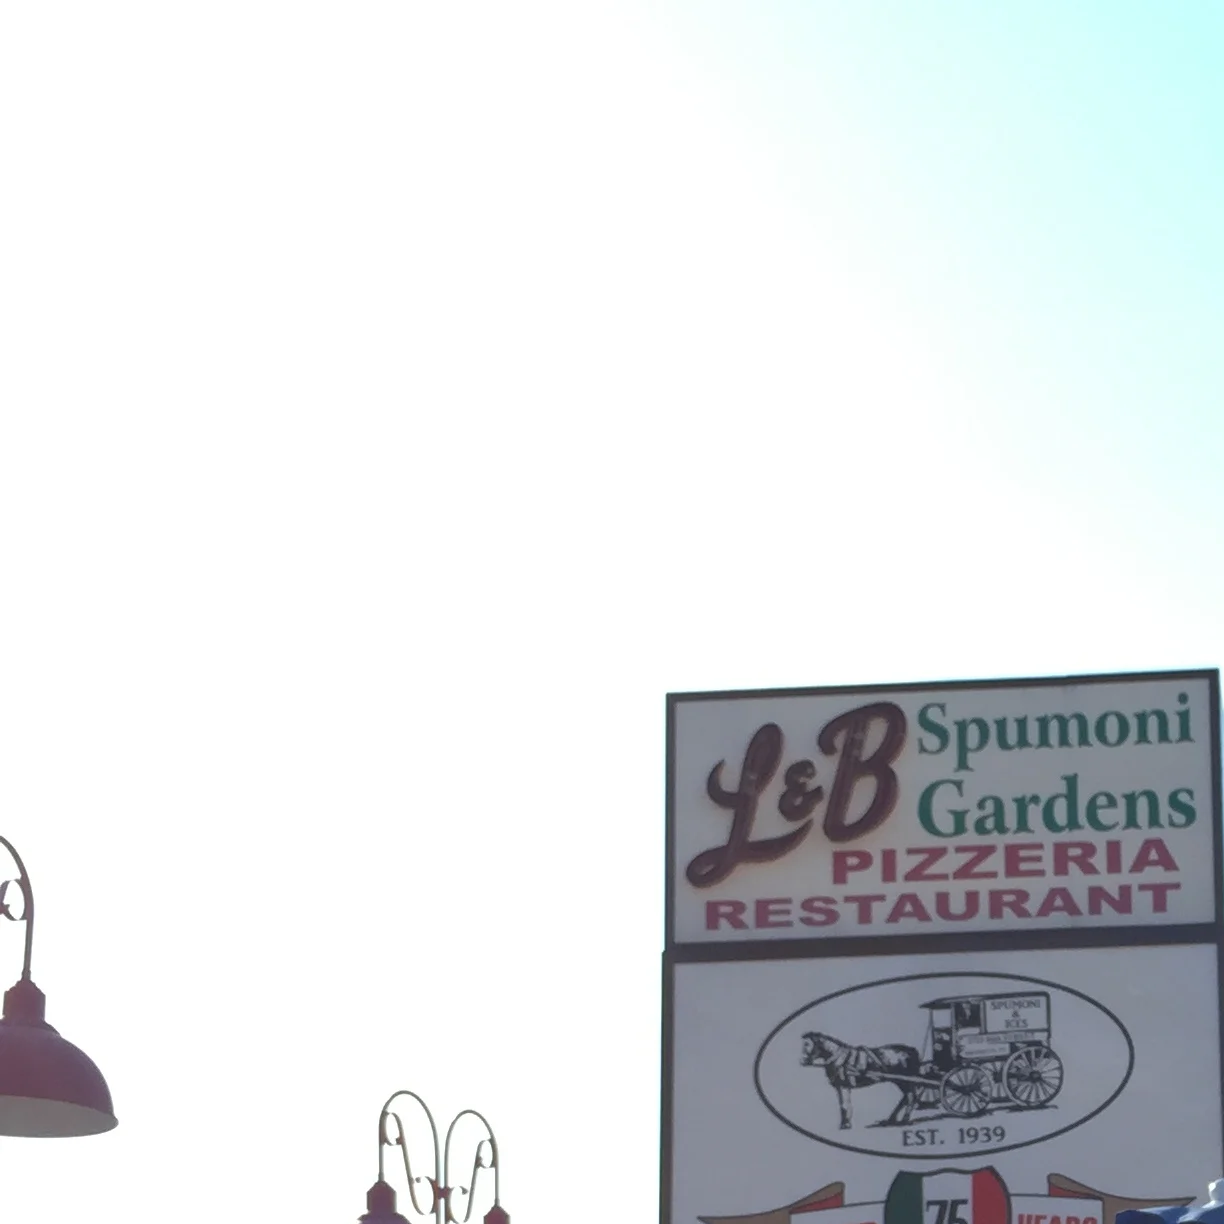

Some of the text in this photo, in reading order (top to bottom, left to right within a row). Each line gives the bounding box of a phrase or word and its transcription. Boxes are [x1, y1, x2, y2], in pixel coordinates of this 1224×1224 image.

[916, 692, 1196, 772] Spumoni
[686, 701, 908, 888] L&B
[916, 773, 1198, 839] Gardens
[831, 838, 1181, 886] PIZZERIA
[704, 882, 1182, 932] RESTAURANT
[903, 1126, 1006, 1147] EST. 1939
